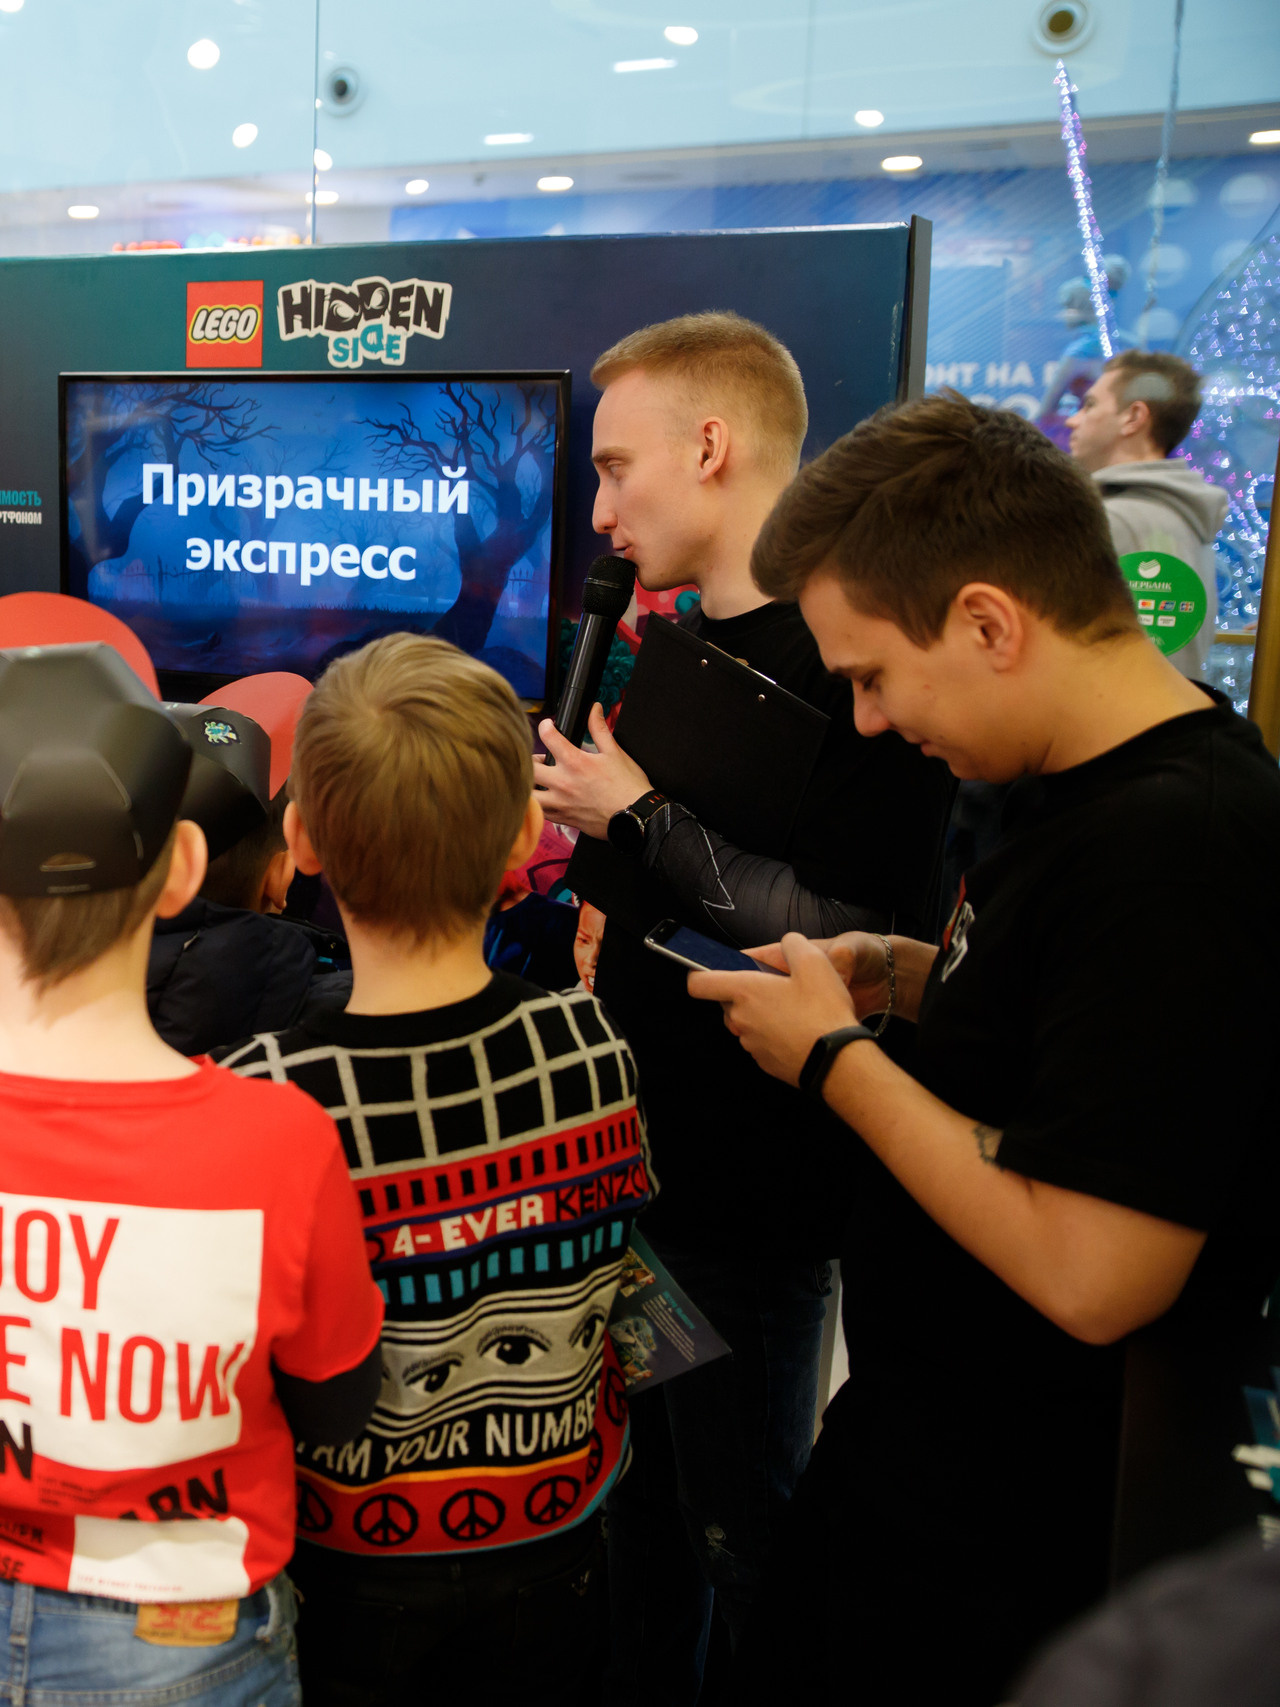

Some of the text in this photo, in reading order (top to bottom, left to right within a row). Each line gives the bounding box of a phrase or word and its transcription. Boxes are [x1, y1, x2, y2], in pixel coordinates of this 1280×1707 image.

[190, 306, 260, 342] LEGO
[280, 278, 446, 335] HIDDEN
[332, 323, 402, 363] SIDE
[142, 463, 470, 520] Призрачный
[185, 537, 417, 586] экспресс
[60, 1326, 246, 1424] NOW
[385, 1419, 470, 1474] YOUR
